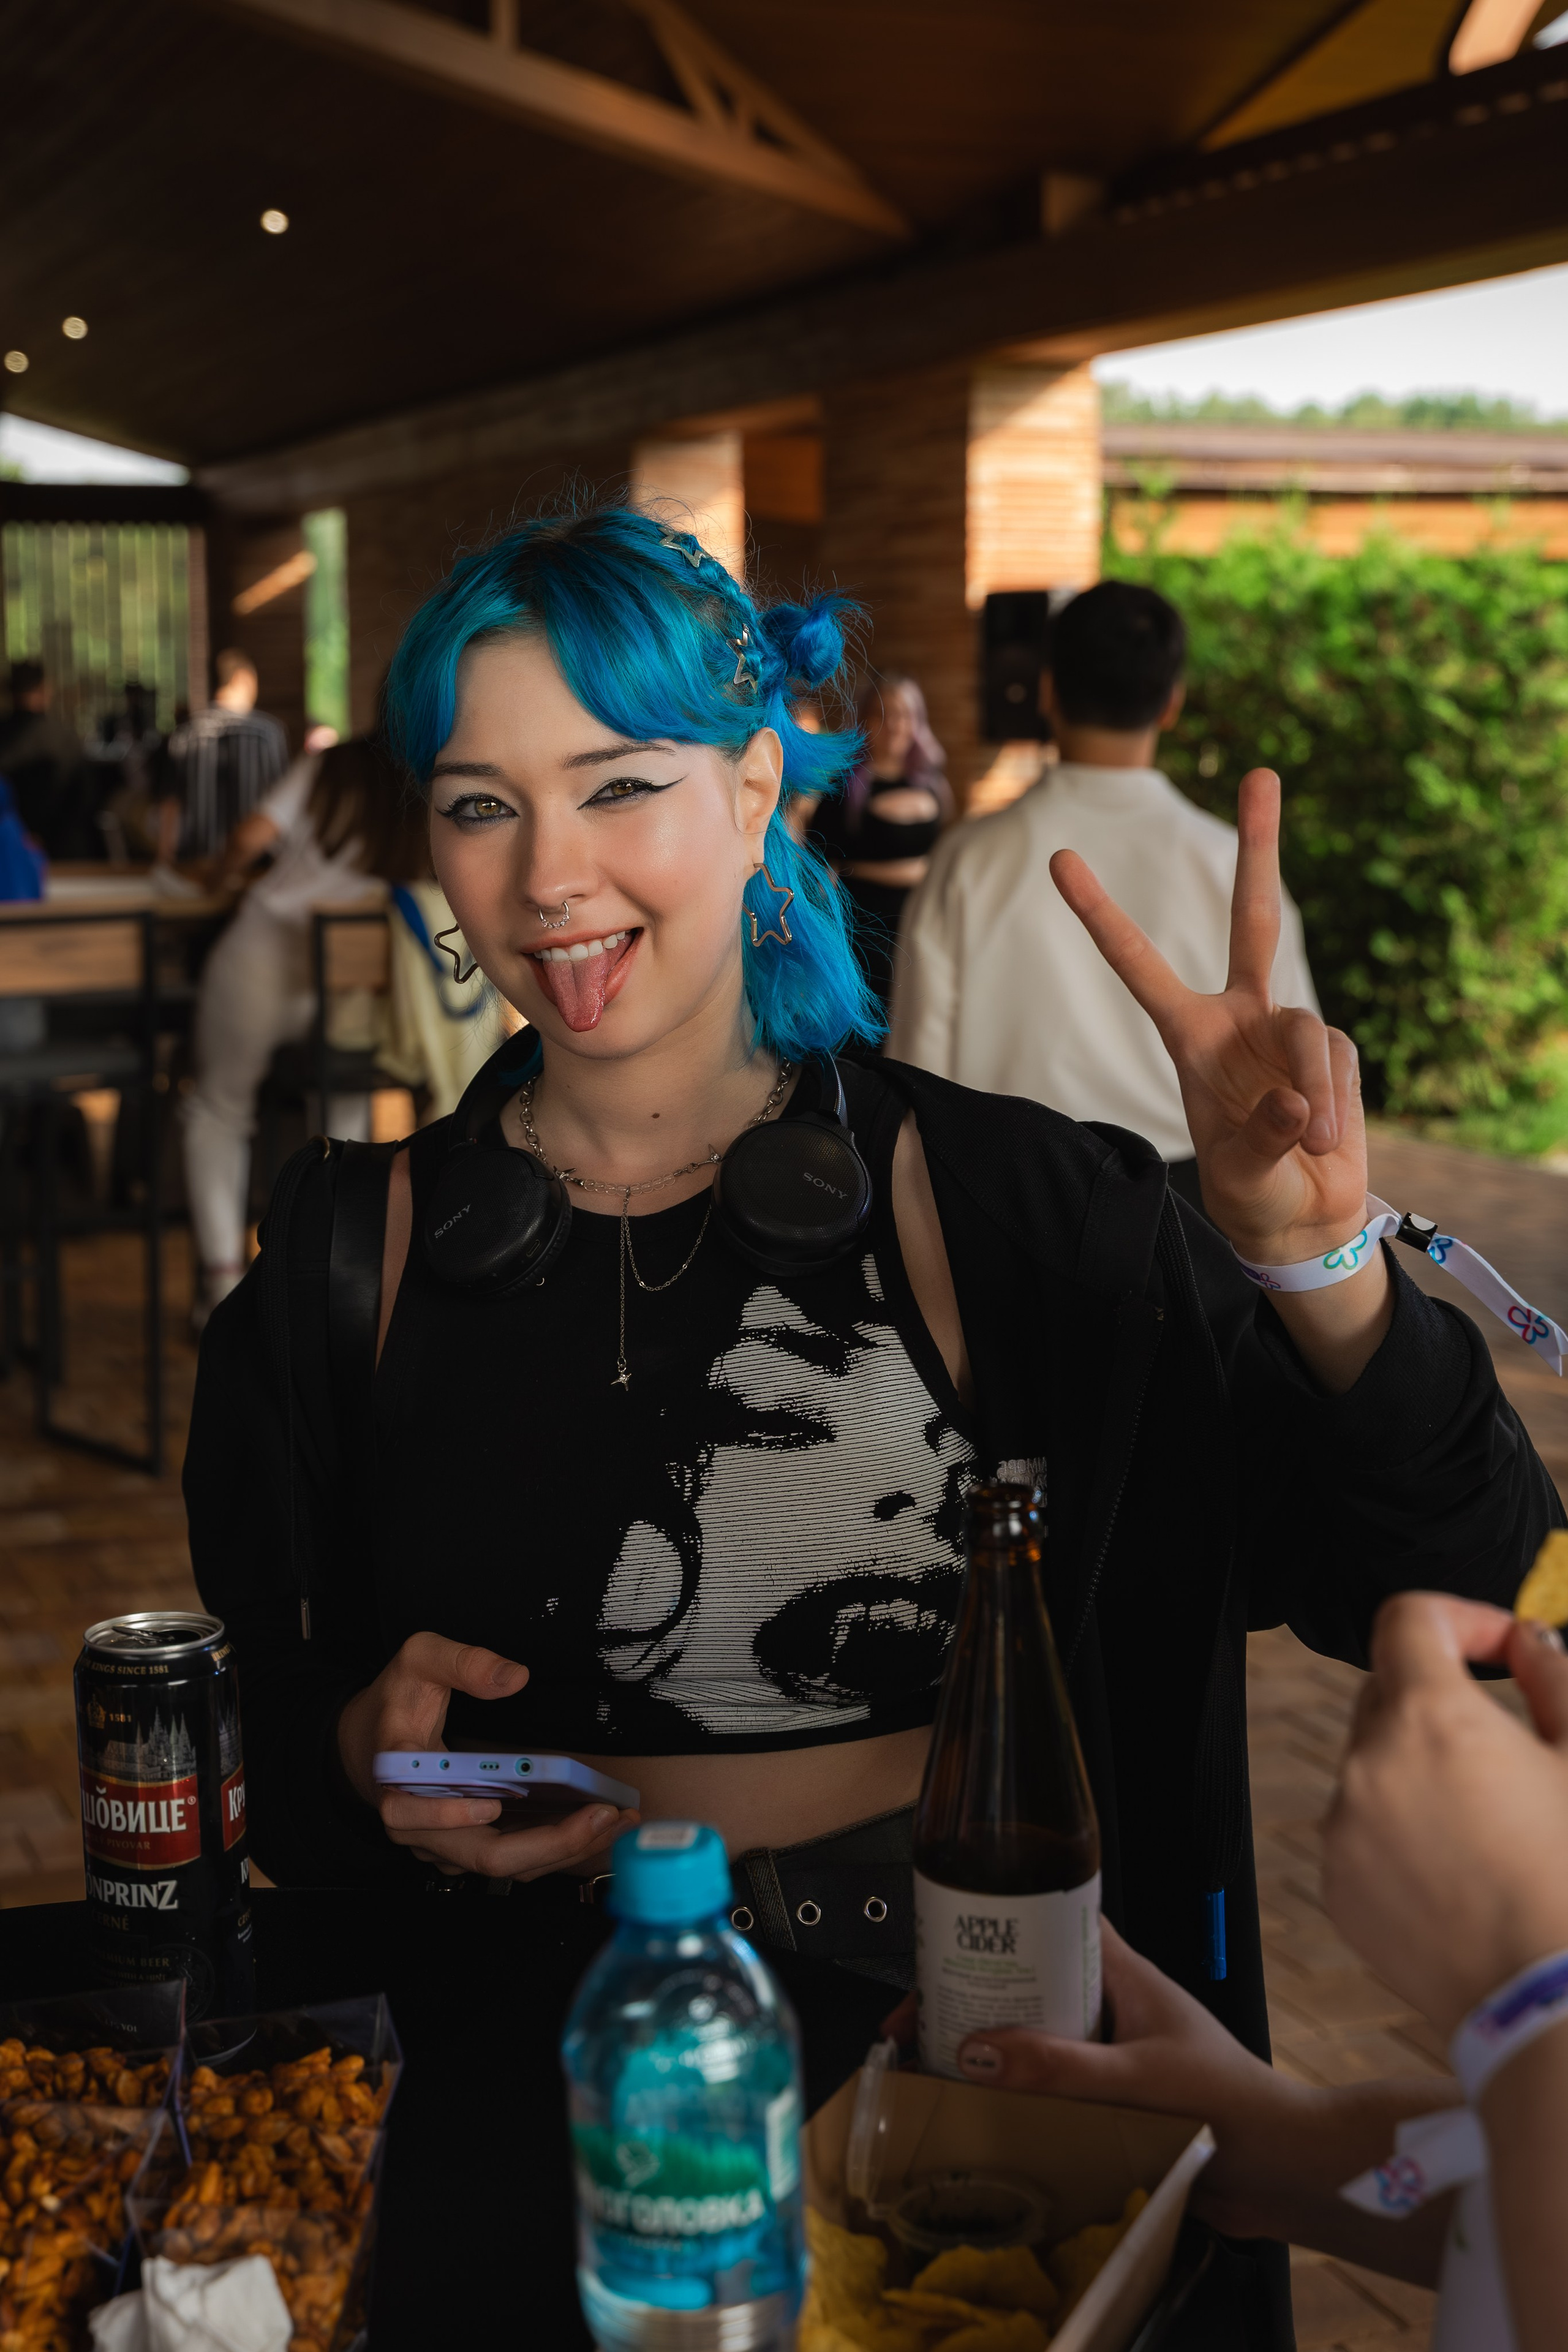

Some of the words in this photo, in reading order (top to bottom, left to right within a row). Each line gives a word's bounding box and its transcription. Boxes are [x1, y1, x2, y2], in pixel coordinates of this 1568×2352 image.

[802, 1172, 848, 1199] SONY
[434, 1204, 470, 1238] SONY
[117, 1665, 146, 1675] SINCE
[148, 1664, 170, 1675] 1581
[108, 1713, 132, 1723] 1581
[107, 1838, 151, 1850] PIVOVAR
[954, 1913, 1020, 1937] APPLE
[956, 1929, 1016, 1954] CIDER
[140, 1957, 170, 1967] BEER
